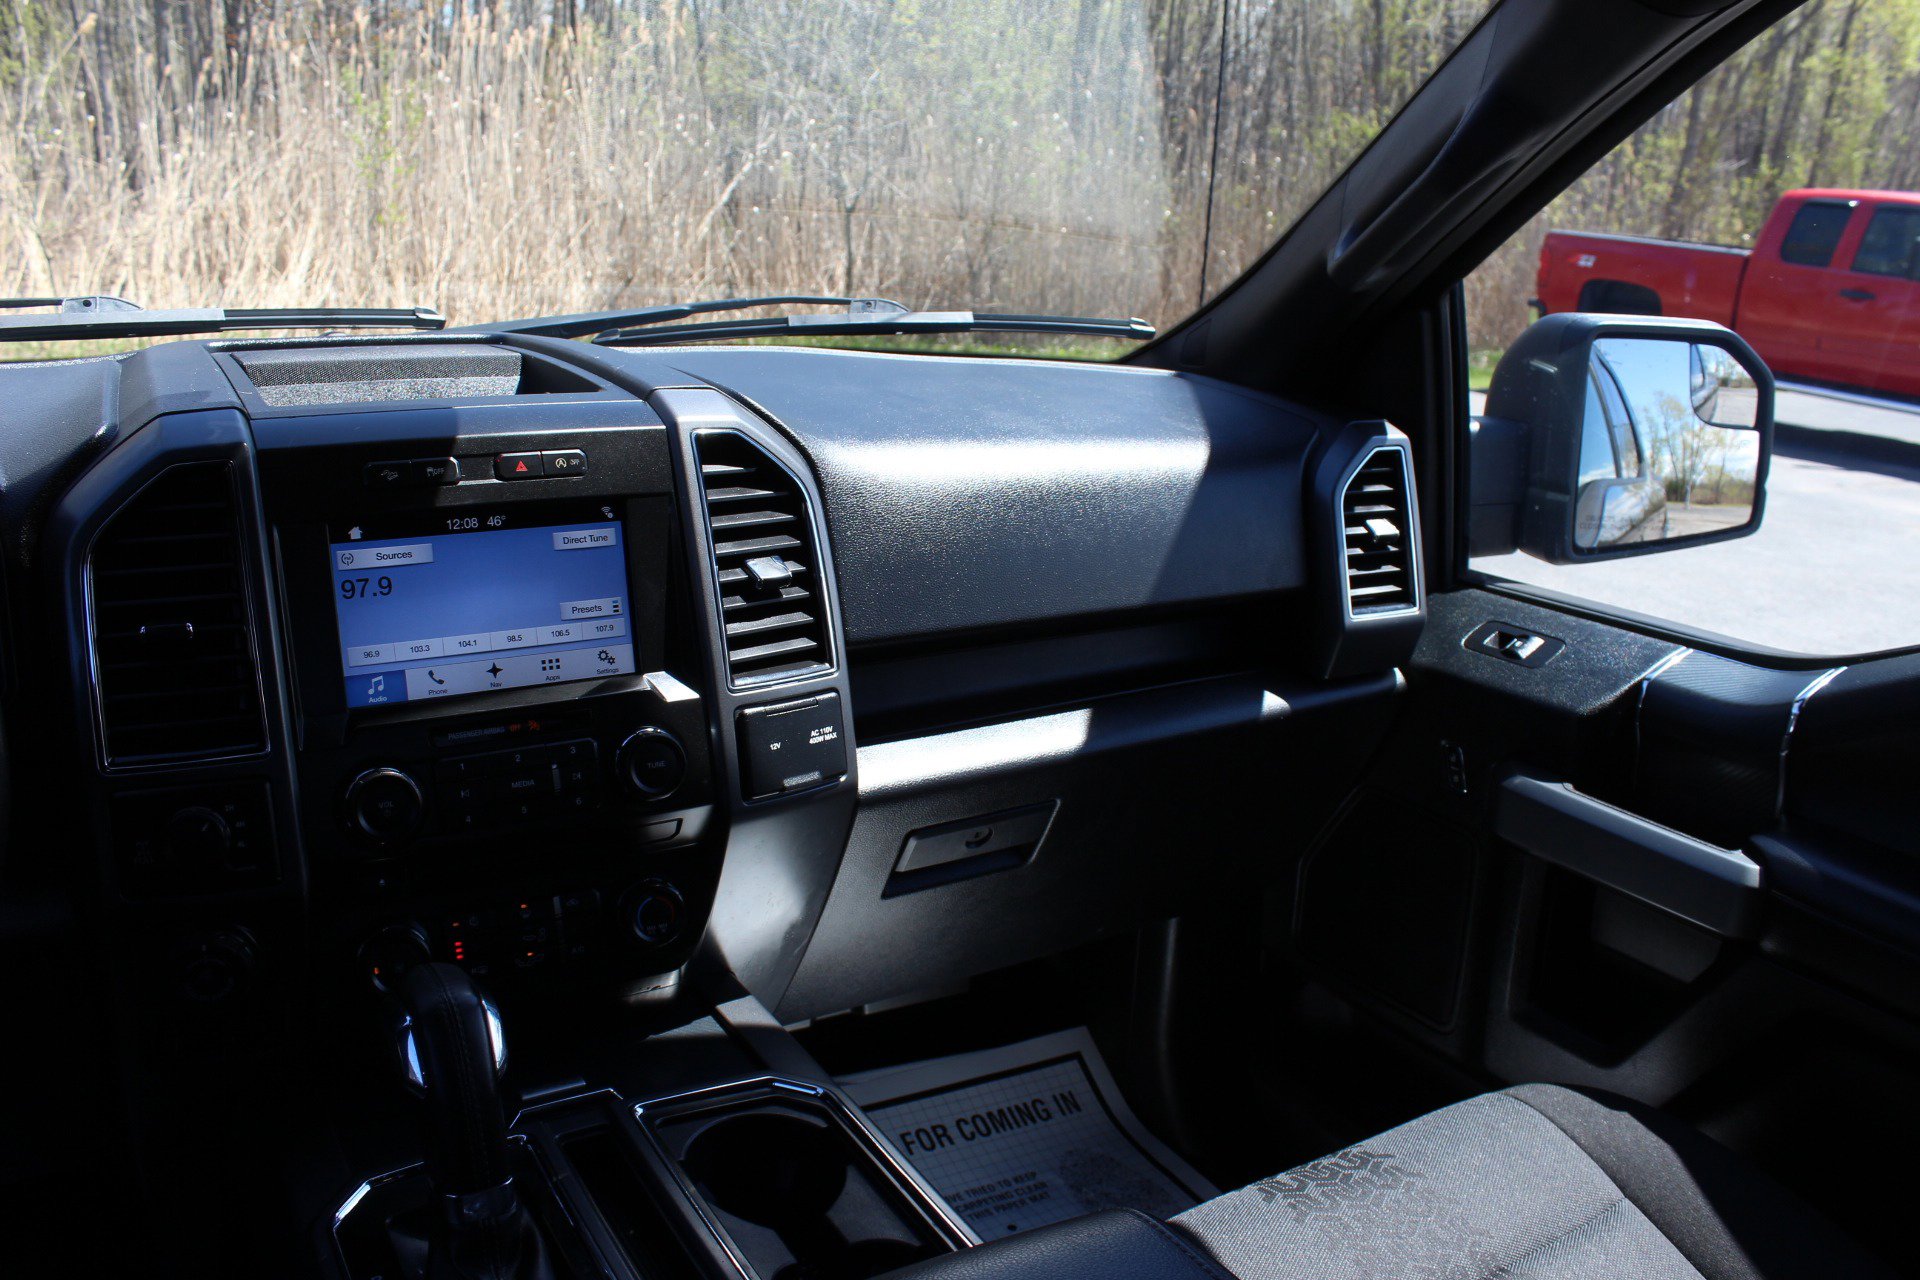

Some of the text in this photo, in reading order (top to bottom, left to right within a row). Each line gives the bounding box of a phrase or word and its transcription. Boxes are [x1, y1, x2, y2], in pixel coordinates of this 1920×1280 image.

[446, 517, 479, 530] 12:08
[563, 533, 608, 545] Direct Tune
[376, 550, 413, 561] Sources
[340, 576, 393, 600] 97.9
[571, 603, 602, 615] Presets
[550, 628, 570, 638] 106.5
[595, 624, 614, 633] 107.9
[506, 634, 523, 643] 98.5
[457, 639, 478, 648] 104.1
[409, 644, 430, 654] 103.3
[363, 650, 380, 659] 96.9
[596, 667, 619, 675] Settings
[545, 674, 561, 682] Apps
[428, 687, 448, 696] Phone
[368, 695, 387, 704] Audio
[811, 726, 834, 738] AC 110V
[824, 732, 838, 741] MAX
[769, 742, 782, 751] 12V
[647, 760, 667, 769] TUNE
[511, 778, 535, 788] MEDIA
[899, 1090, 1082, 1155] FOR COMING IN
[965, 1183, 996, 1198] TRIED
[998, 1178, 1012, 1189] TO
